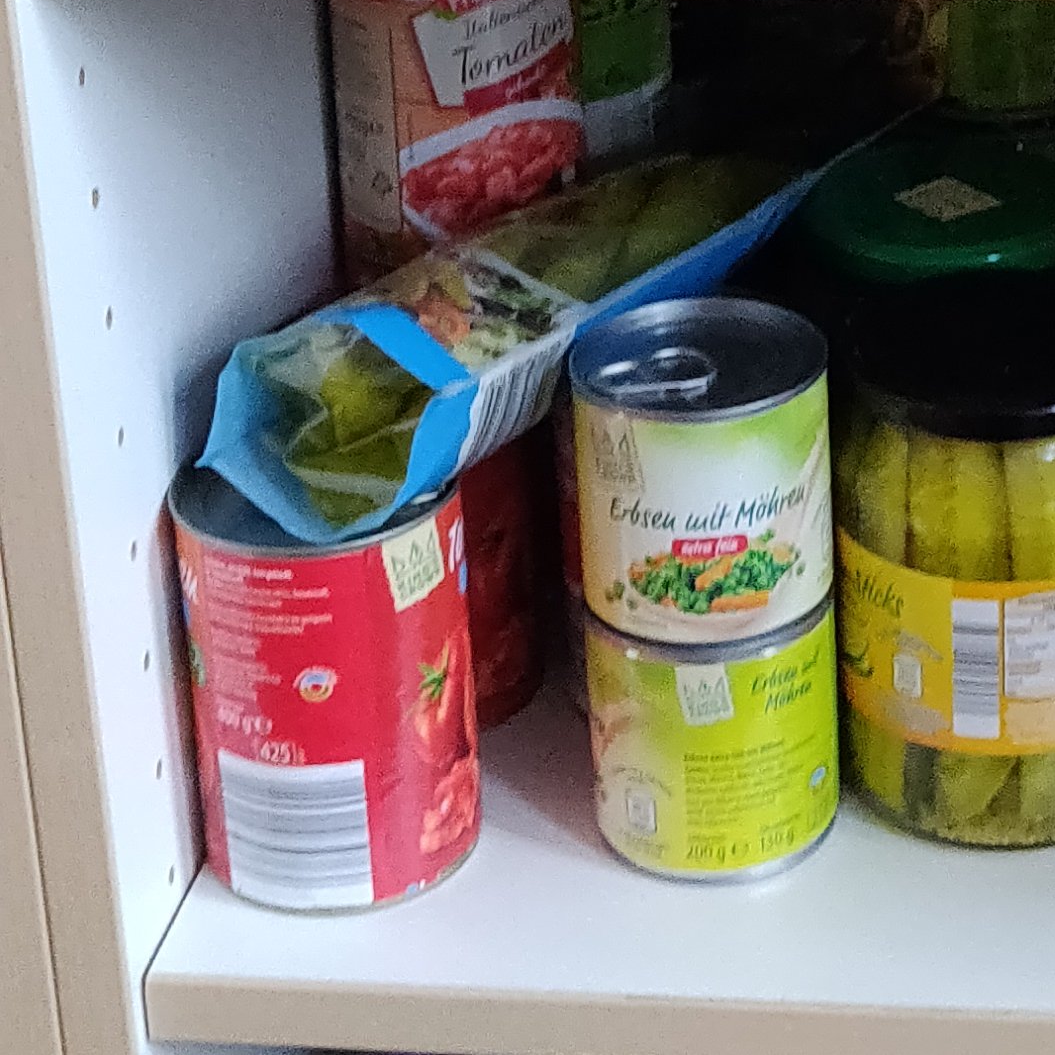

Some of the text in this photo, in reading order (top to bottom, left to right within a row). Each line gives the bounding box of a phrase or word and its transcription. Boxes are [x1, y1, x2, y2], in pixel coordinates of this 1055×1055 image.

[451, 17, 564, 86] Tomaten
[610, 495, 675, 531] Erbsen
[685, 503, 728, 533] mit
